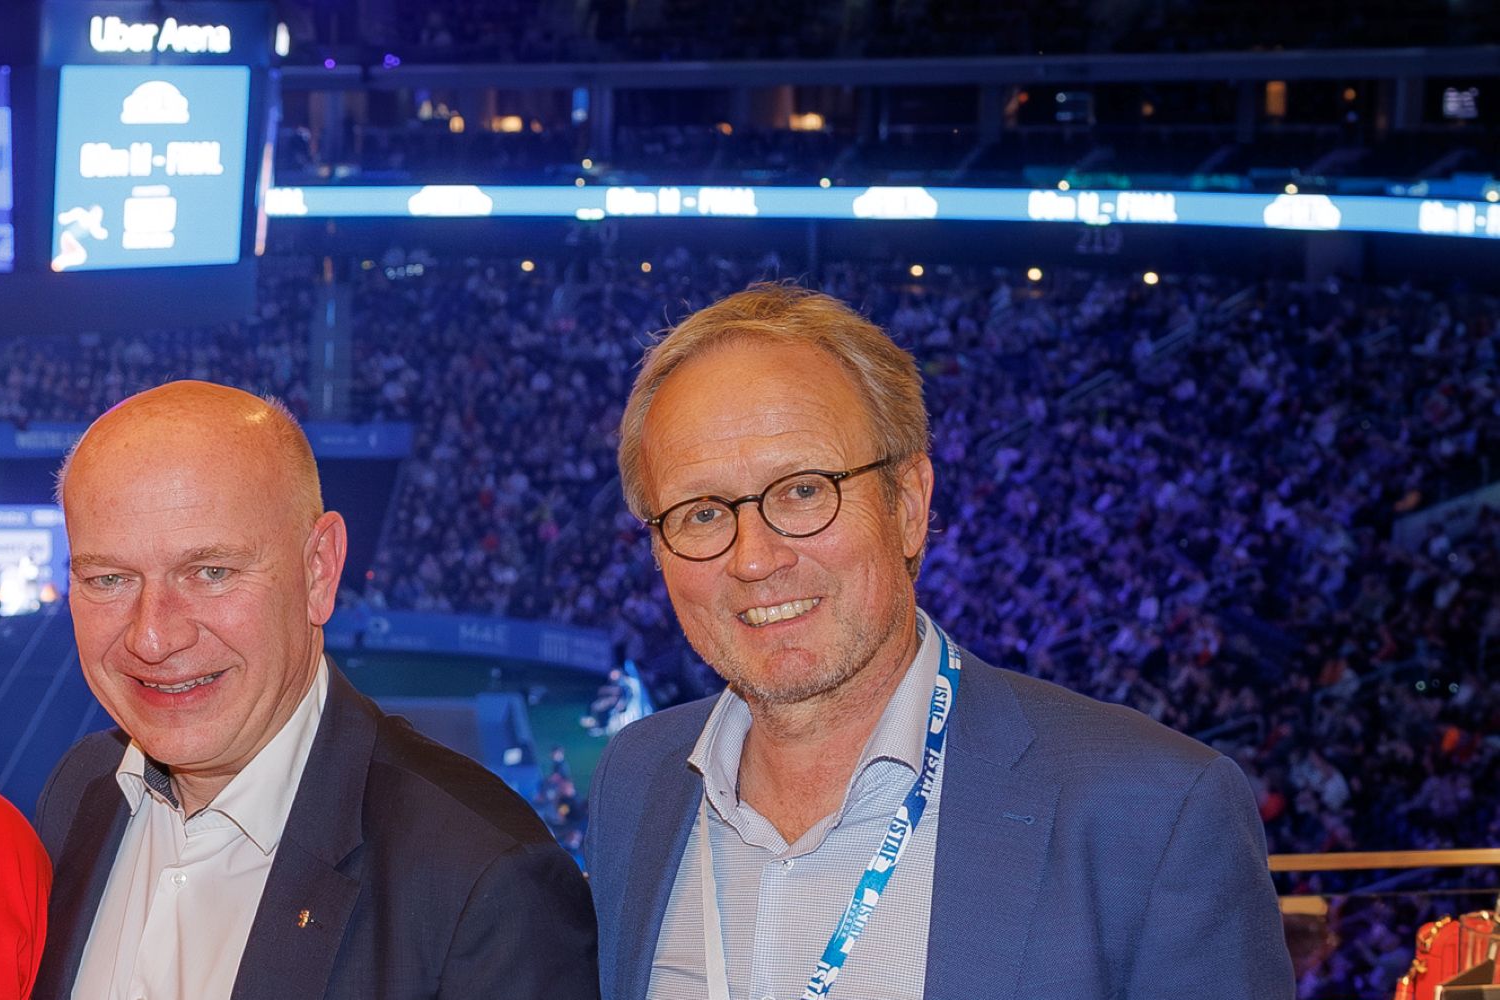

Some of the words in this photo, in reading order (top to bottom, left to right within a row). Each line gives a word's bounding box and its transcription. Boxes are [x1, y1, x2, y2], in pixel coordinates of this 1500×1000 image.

[90, 16, 159, 52] Uber
[157, 17, 231, 53] Arena
[931, 685, 948, 722] ISTAF
[879, 817, 910, 867] ISTAF
